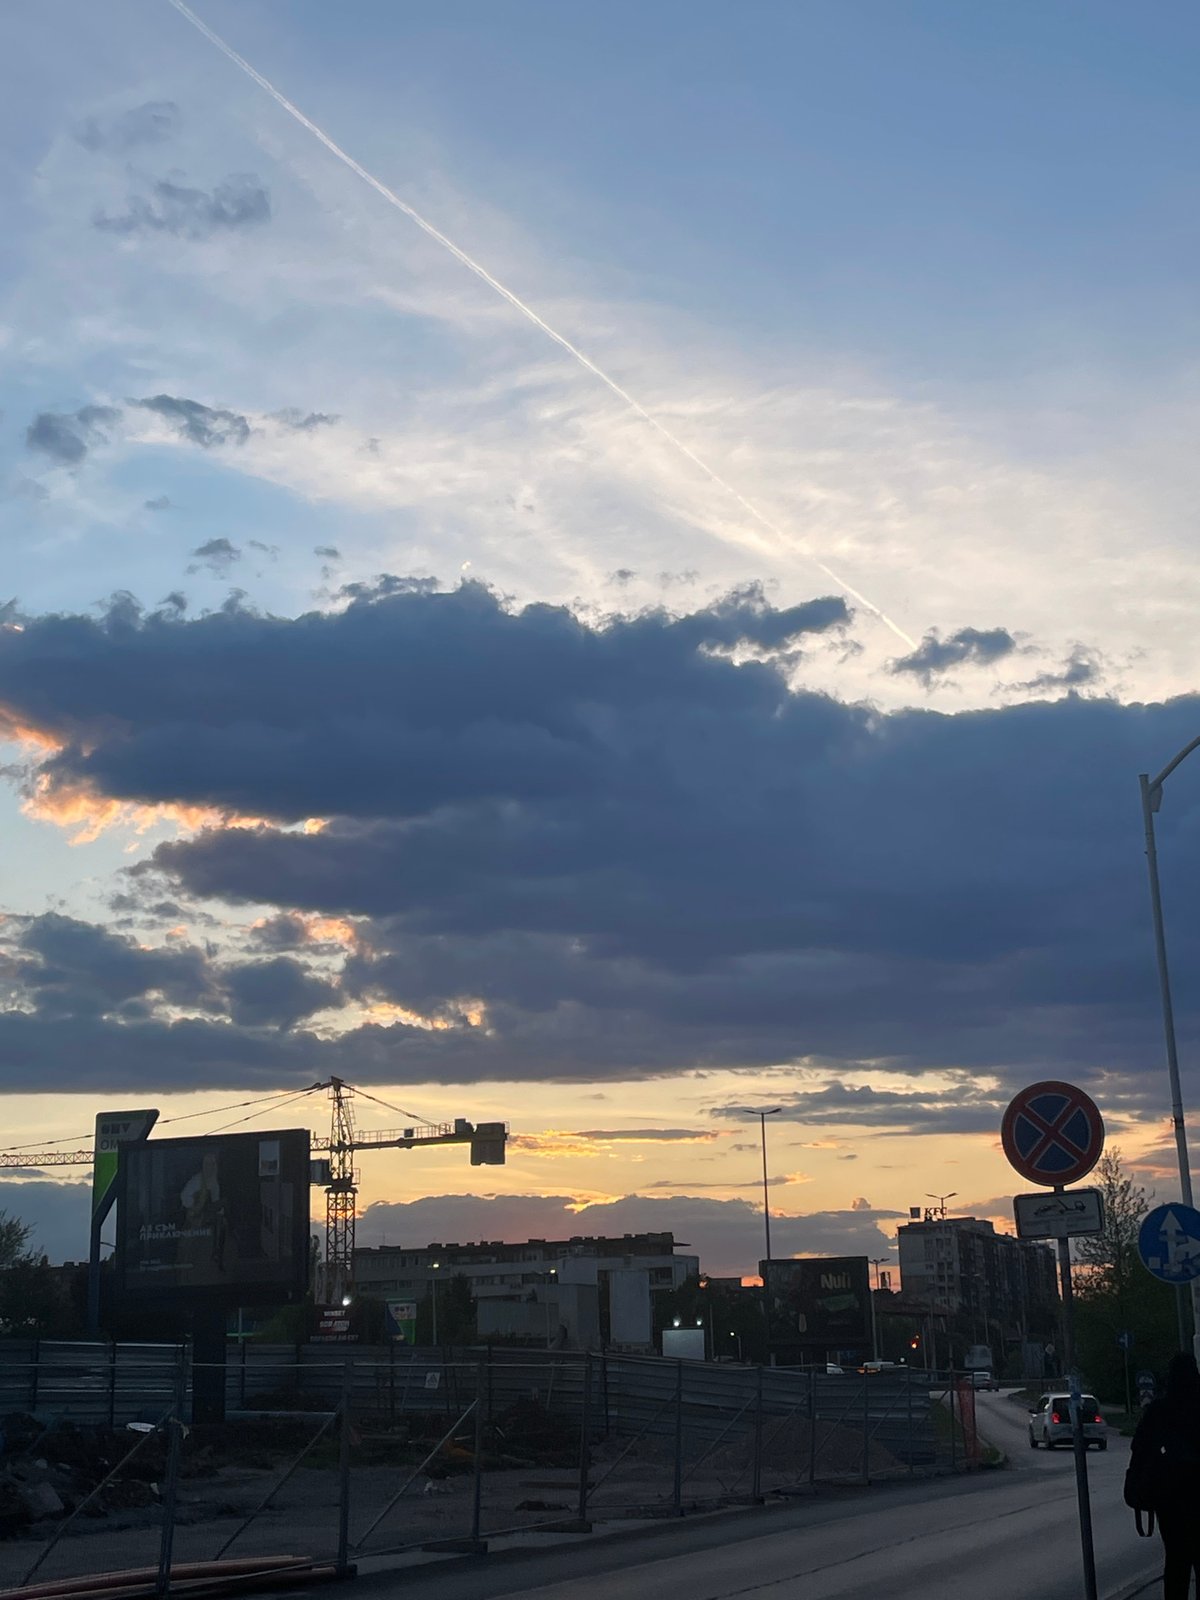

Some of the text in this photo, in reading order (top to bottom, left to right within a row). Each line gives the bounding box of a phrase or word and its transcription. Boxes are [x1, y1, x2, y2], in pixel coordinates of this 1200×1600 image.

[924, 1207, 947, 1216] KFC
[154, 1222, 176, 1232] СЪМ
[139, 1228, 212, 1241] ПРИКЛЮЧЕНИЕ
